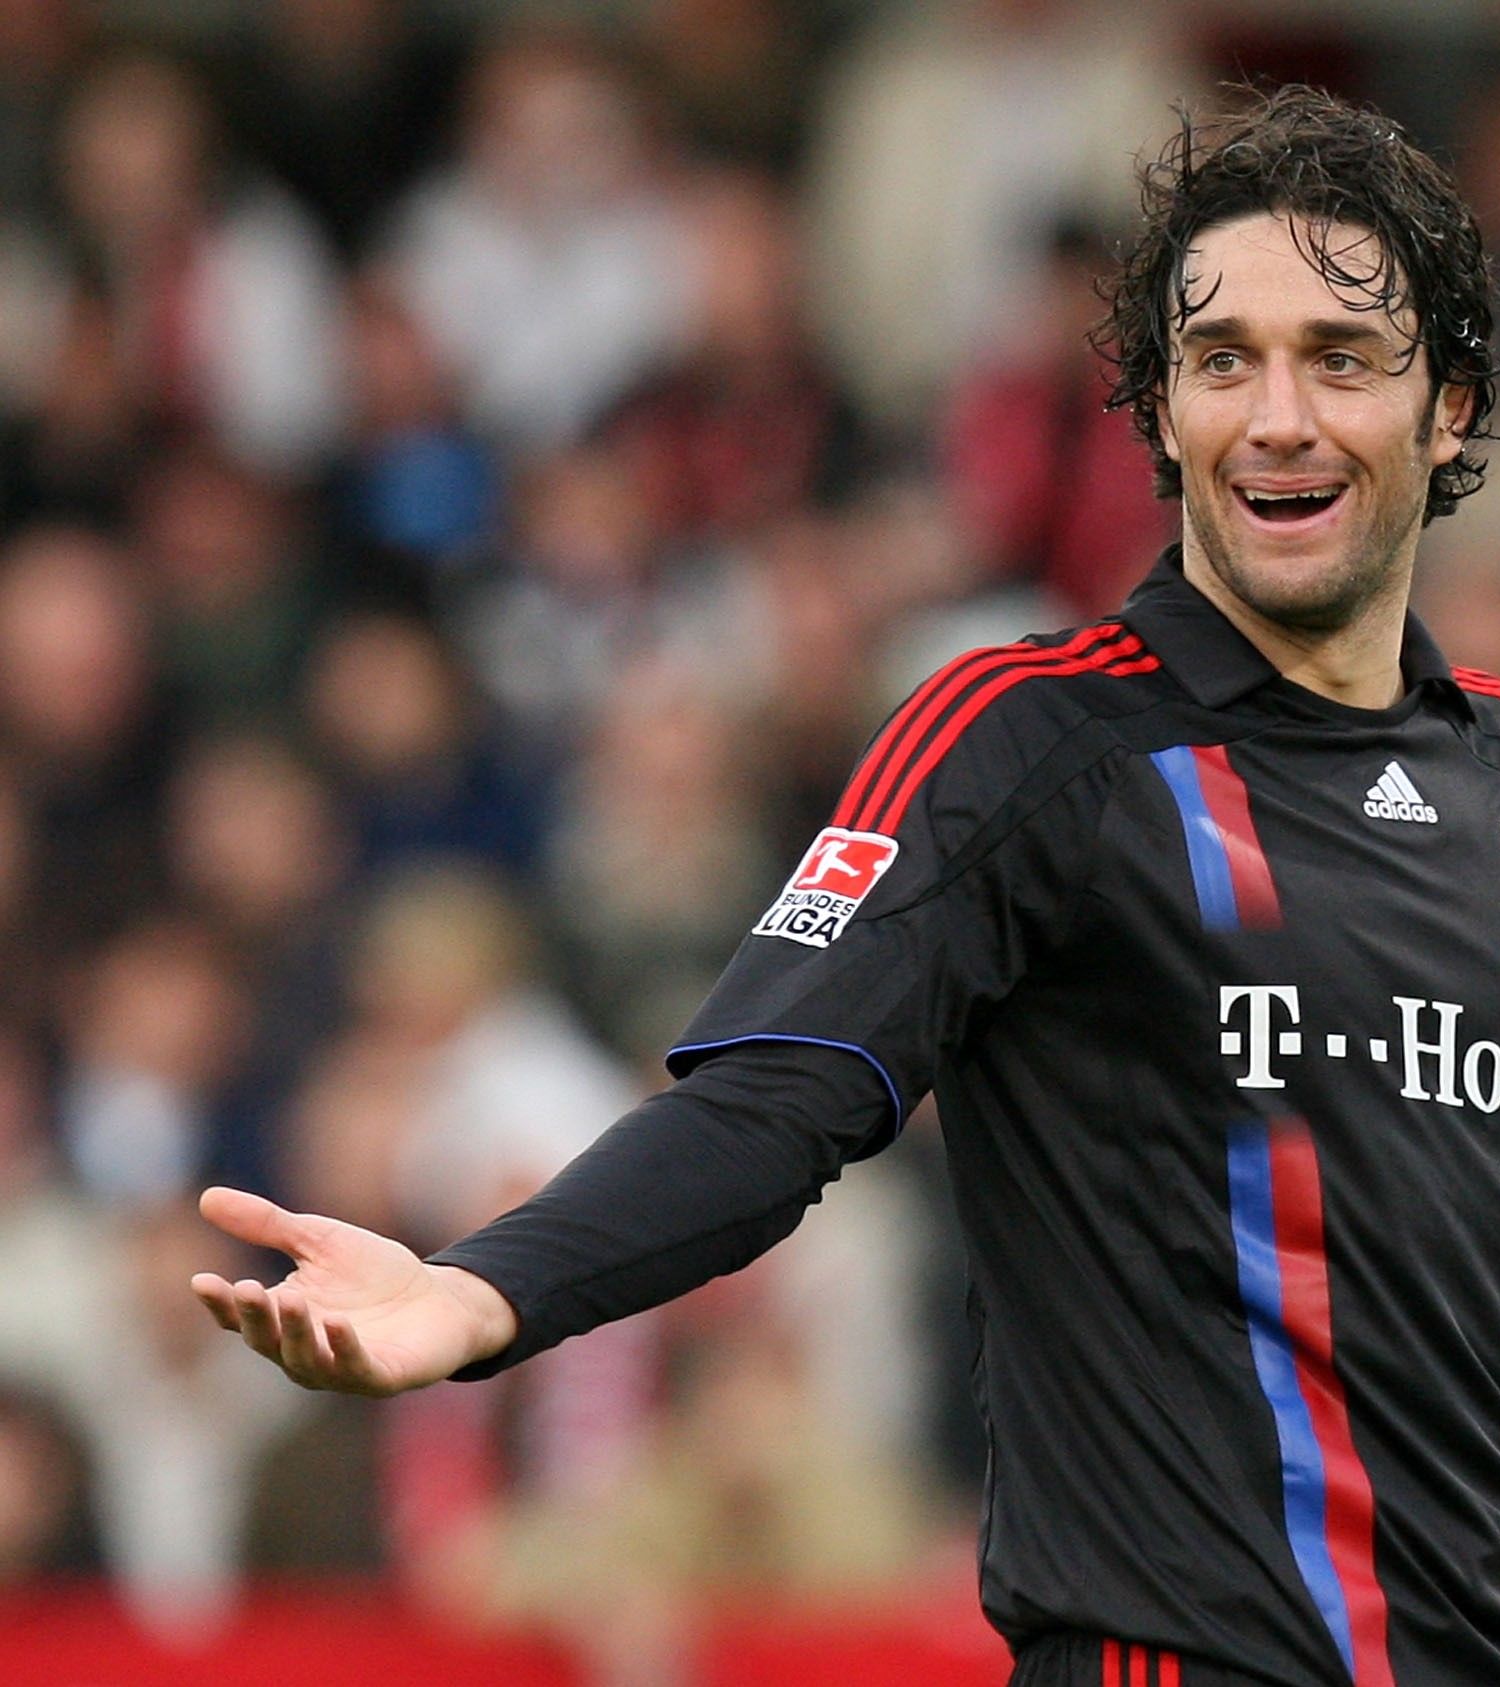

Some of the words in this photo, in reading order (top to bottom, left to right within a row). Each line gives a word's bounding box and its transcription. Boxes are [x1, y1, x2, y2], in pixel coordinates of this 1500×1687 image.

[1363, 800, 1439, 823] adidas
[782, 893, 856, 916] BUNDES
[762, 908, 840, 942] LIGA
